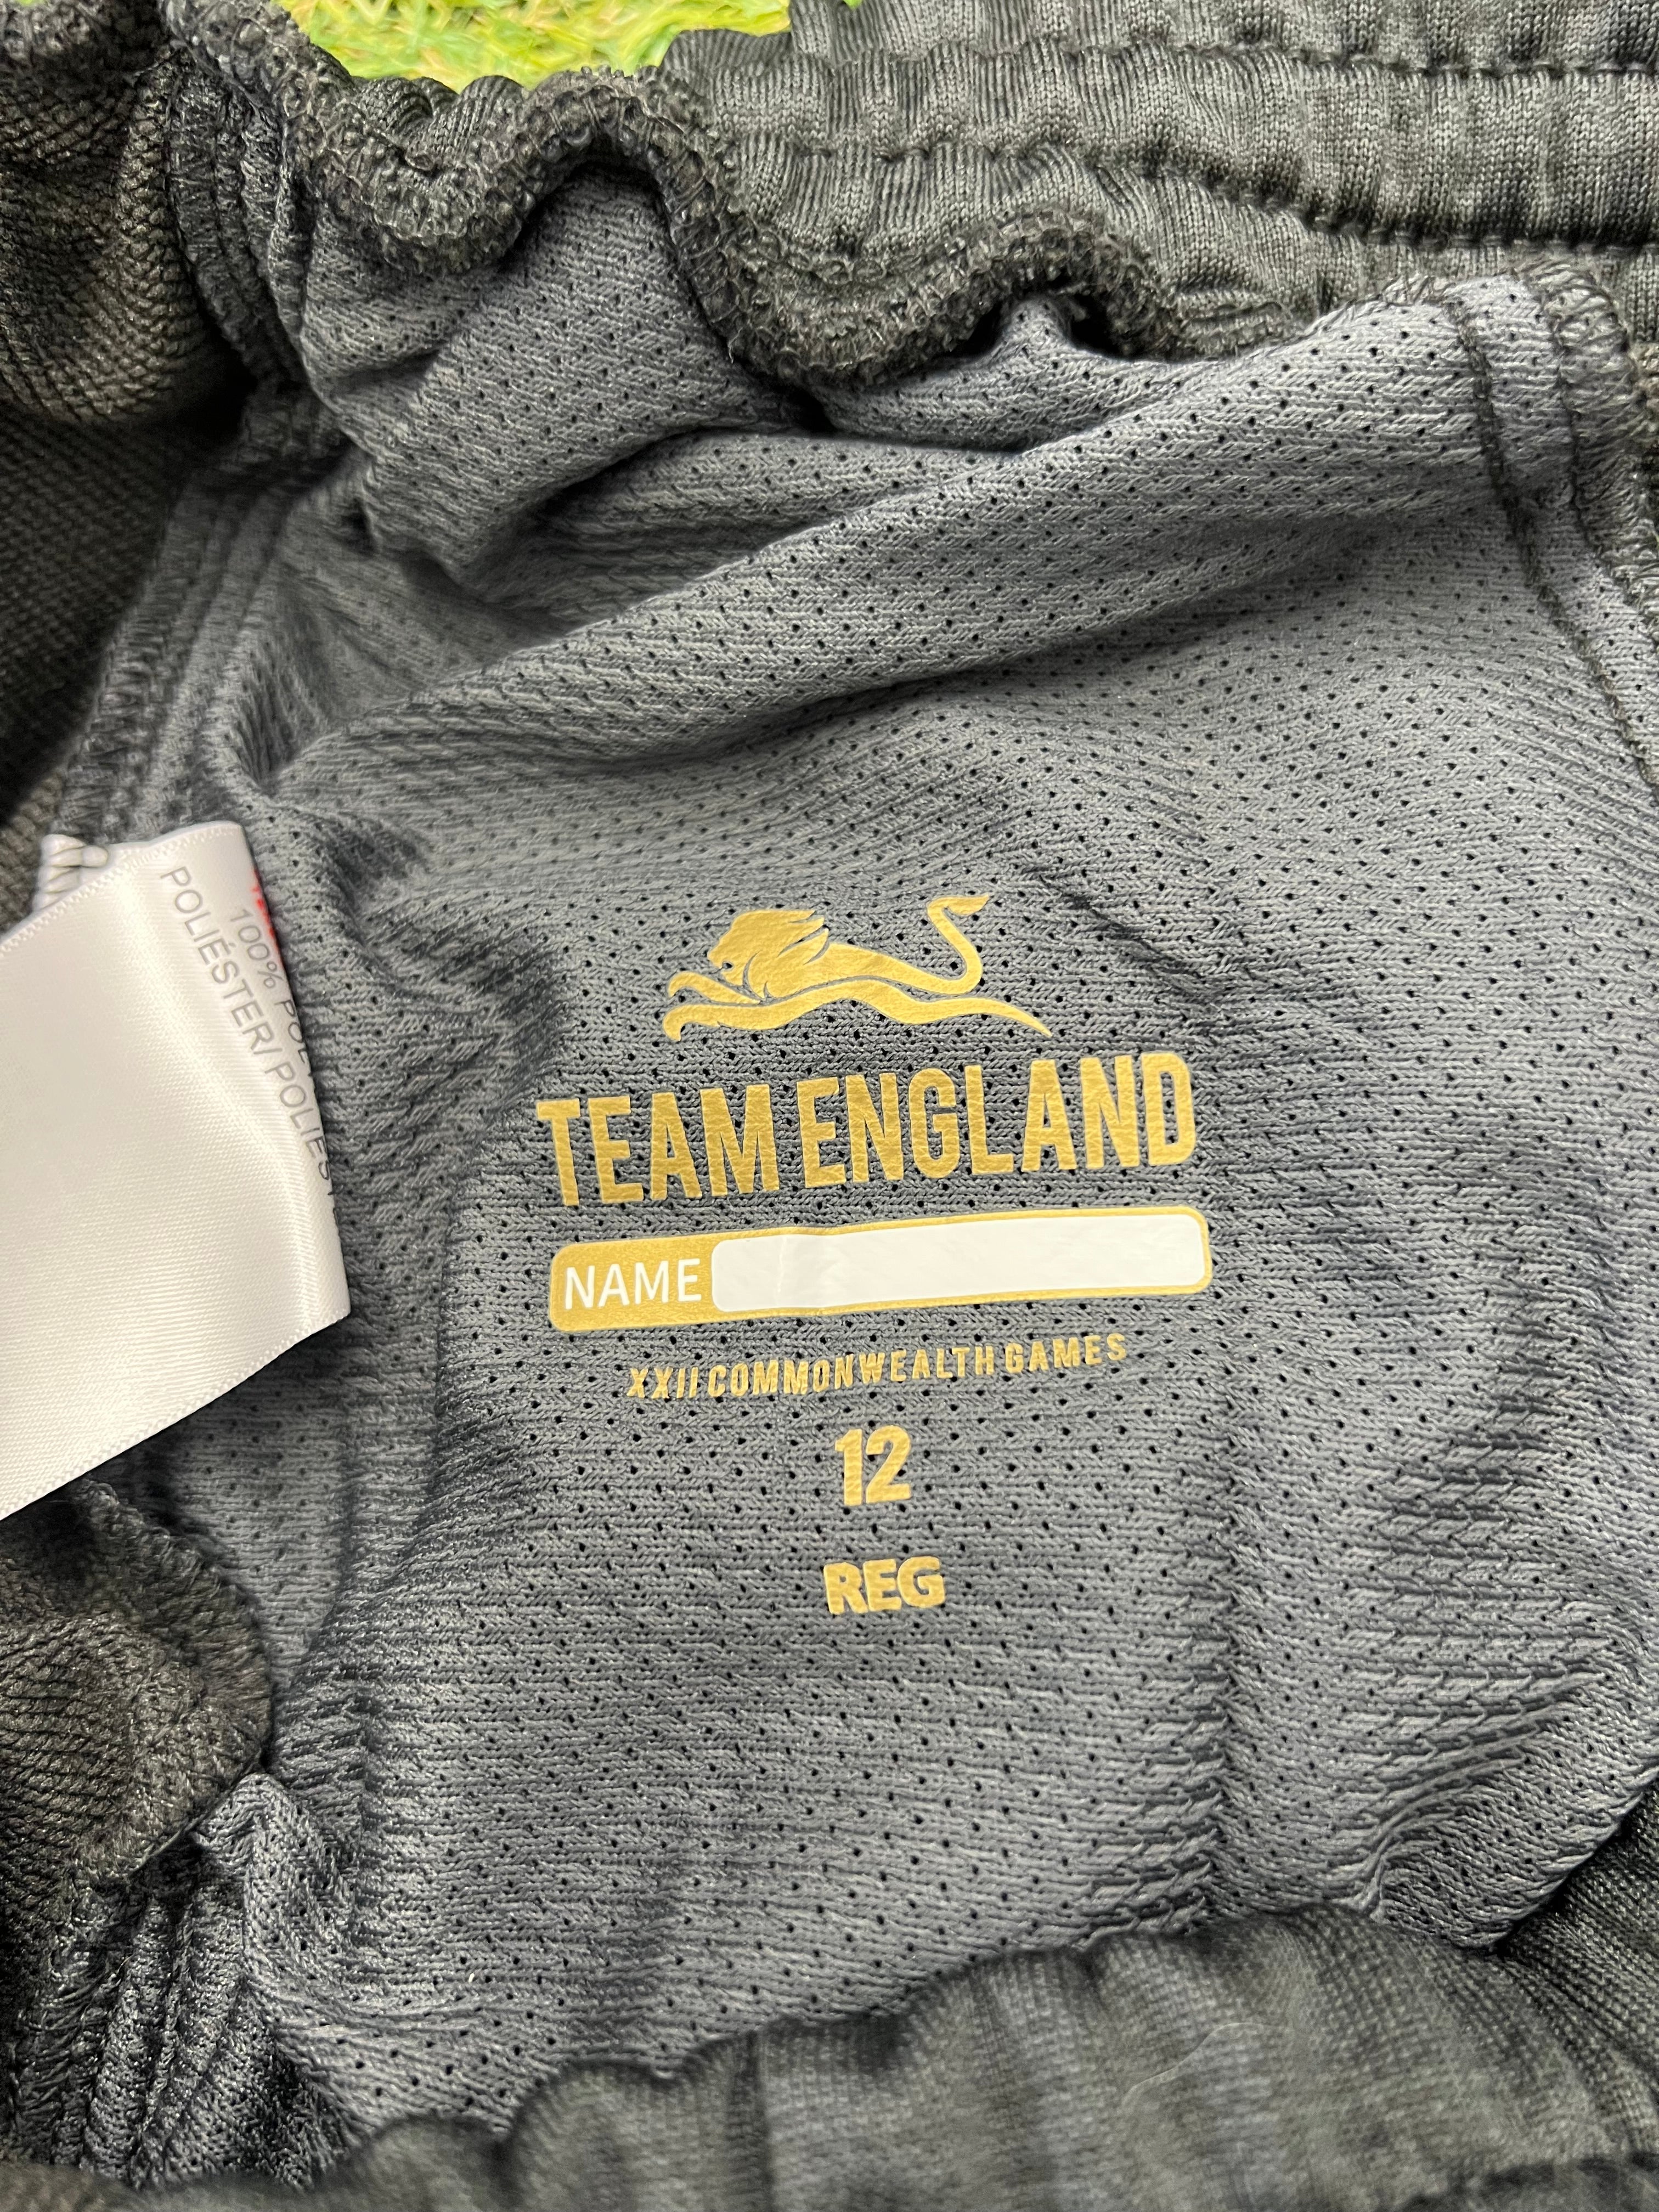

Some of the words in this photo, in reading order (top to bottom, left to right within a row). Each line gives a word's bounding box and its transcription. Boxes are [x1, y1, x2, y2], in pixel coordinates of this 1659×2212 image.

[230, 909, 284, 989] 100%
[274, 999, 312, 1077] POL
[264, 1061, 338, 1228] POLIES
[537, 1084, 780, 1206] TEAM
[796, 1052, 1197, 1189] ENGLAND
[565, 1258, 702, 1310] NAME
[627, 1366, 698, 1398] XXII
[708, 1345, 995, 1397] COMMONWEALTH
[1005, 1333, 1127, 1373] GAMES
[834, 1425, 912, 1506] 12
[823, 1556, 946, 1615] REG
